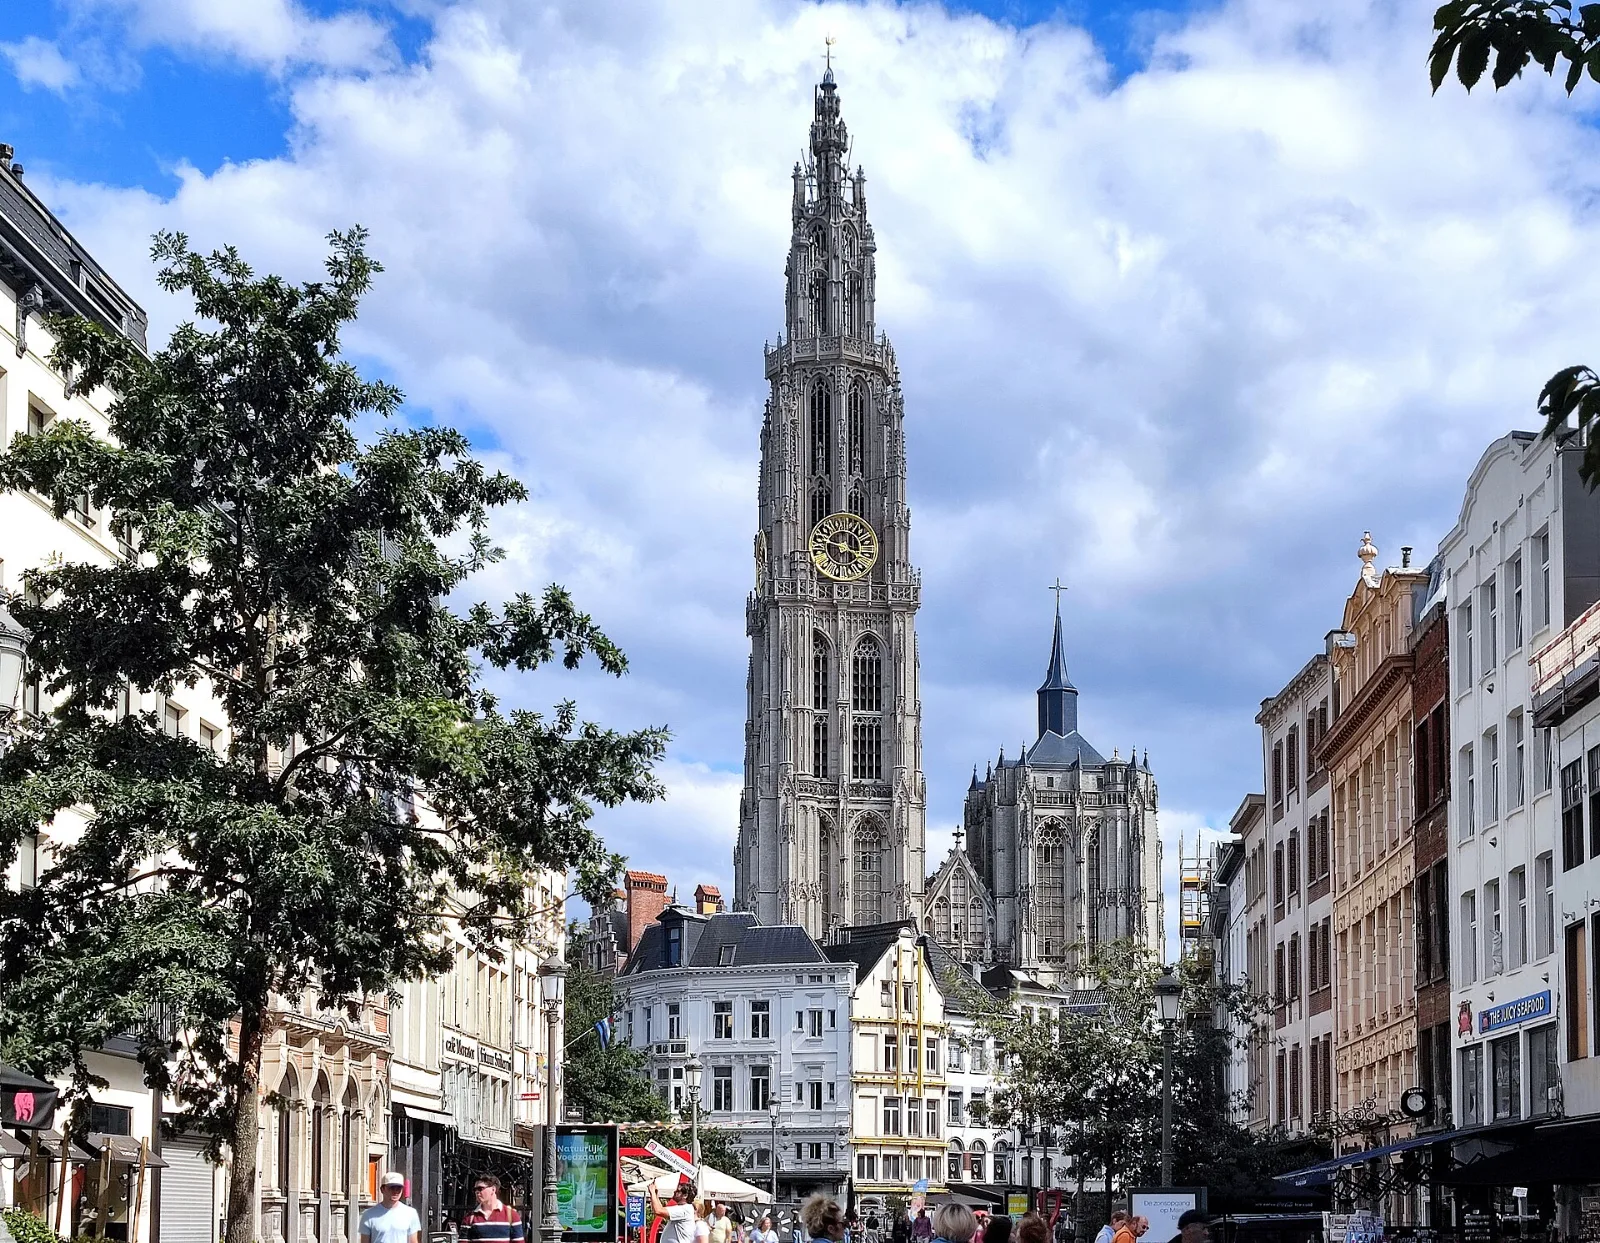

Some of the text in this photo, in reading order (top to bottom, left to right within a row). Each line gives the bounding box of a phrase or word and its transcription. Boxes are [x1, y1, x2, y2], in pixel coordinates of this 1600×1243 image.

[1490, 996, 1544, 1025] THE JUICY SEAFOOD
[557, 1144, 602, 1154] Natuurlijk
